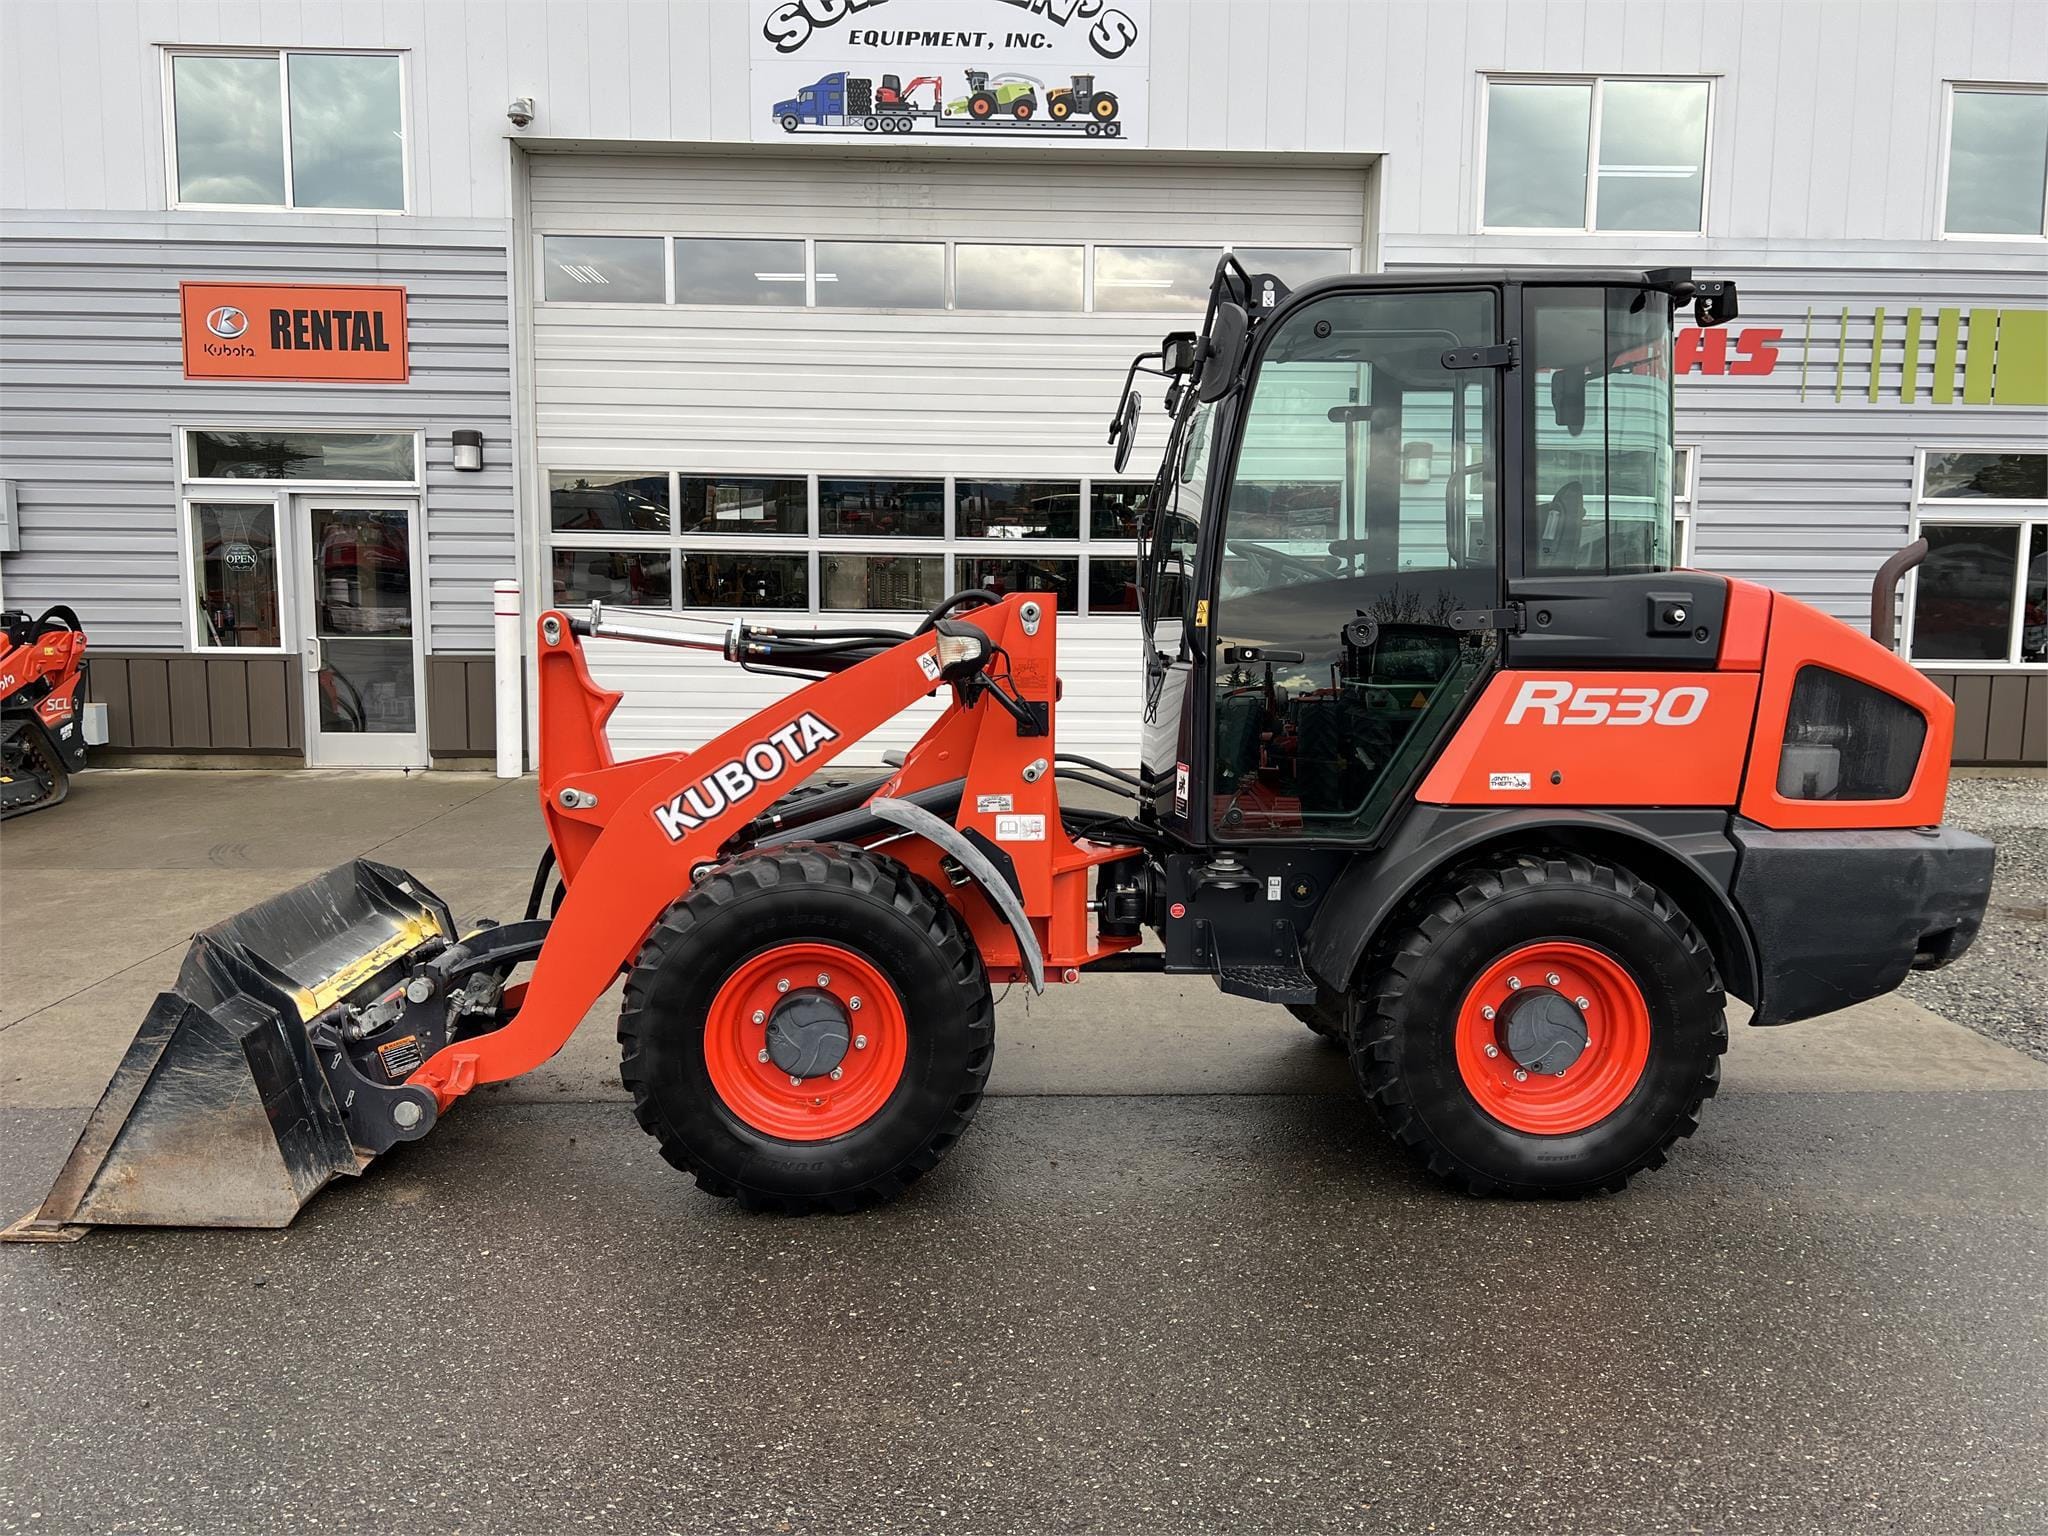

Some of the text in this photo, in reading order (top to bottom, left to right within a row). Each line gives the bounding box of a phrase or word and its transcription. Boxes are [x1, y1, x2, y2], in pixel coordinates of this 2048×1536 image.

[848, 30, 1053, 50] EQUIPMENT, INC.
[270, 309, 390, 352] RENTAL
[203, 343, 254, 357] Kubota
[226, 555, 255, 563] OPEN
[46, 698, 71, 711] SCL
[1504, 680, 1709, 726] R530
[654, 711, 840, 842] KUBOTA
